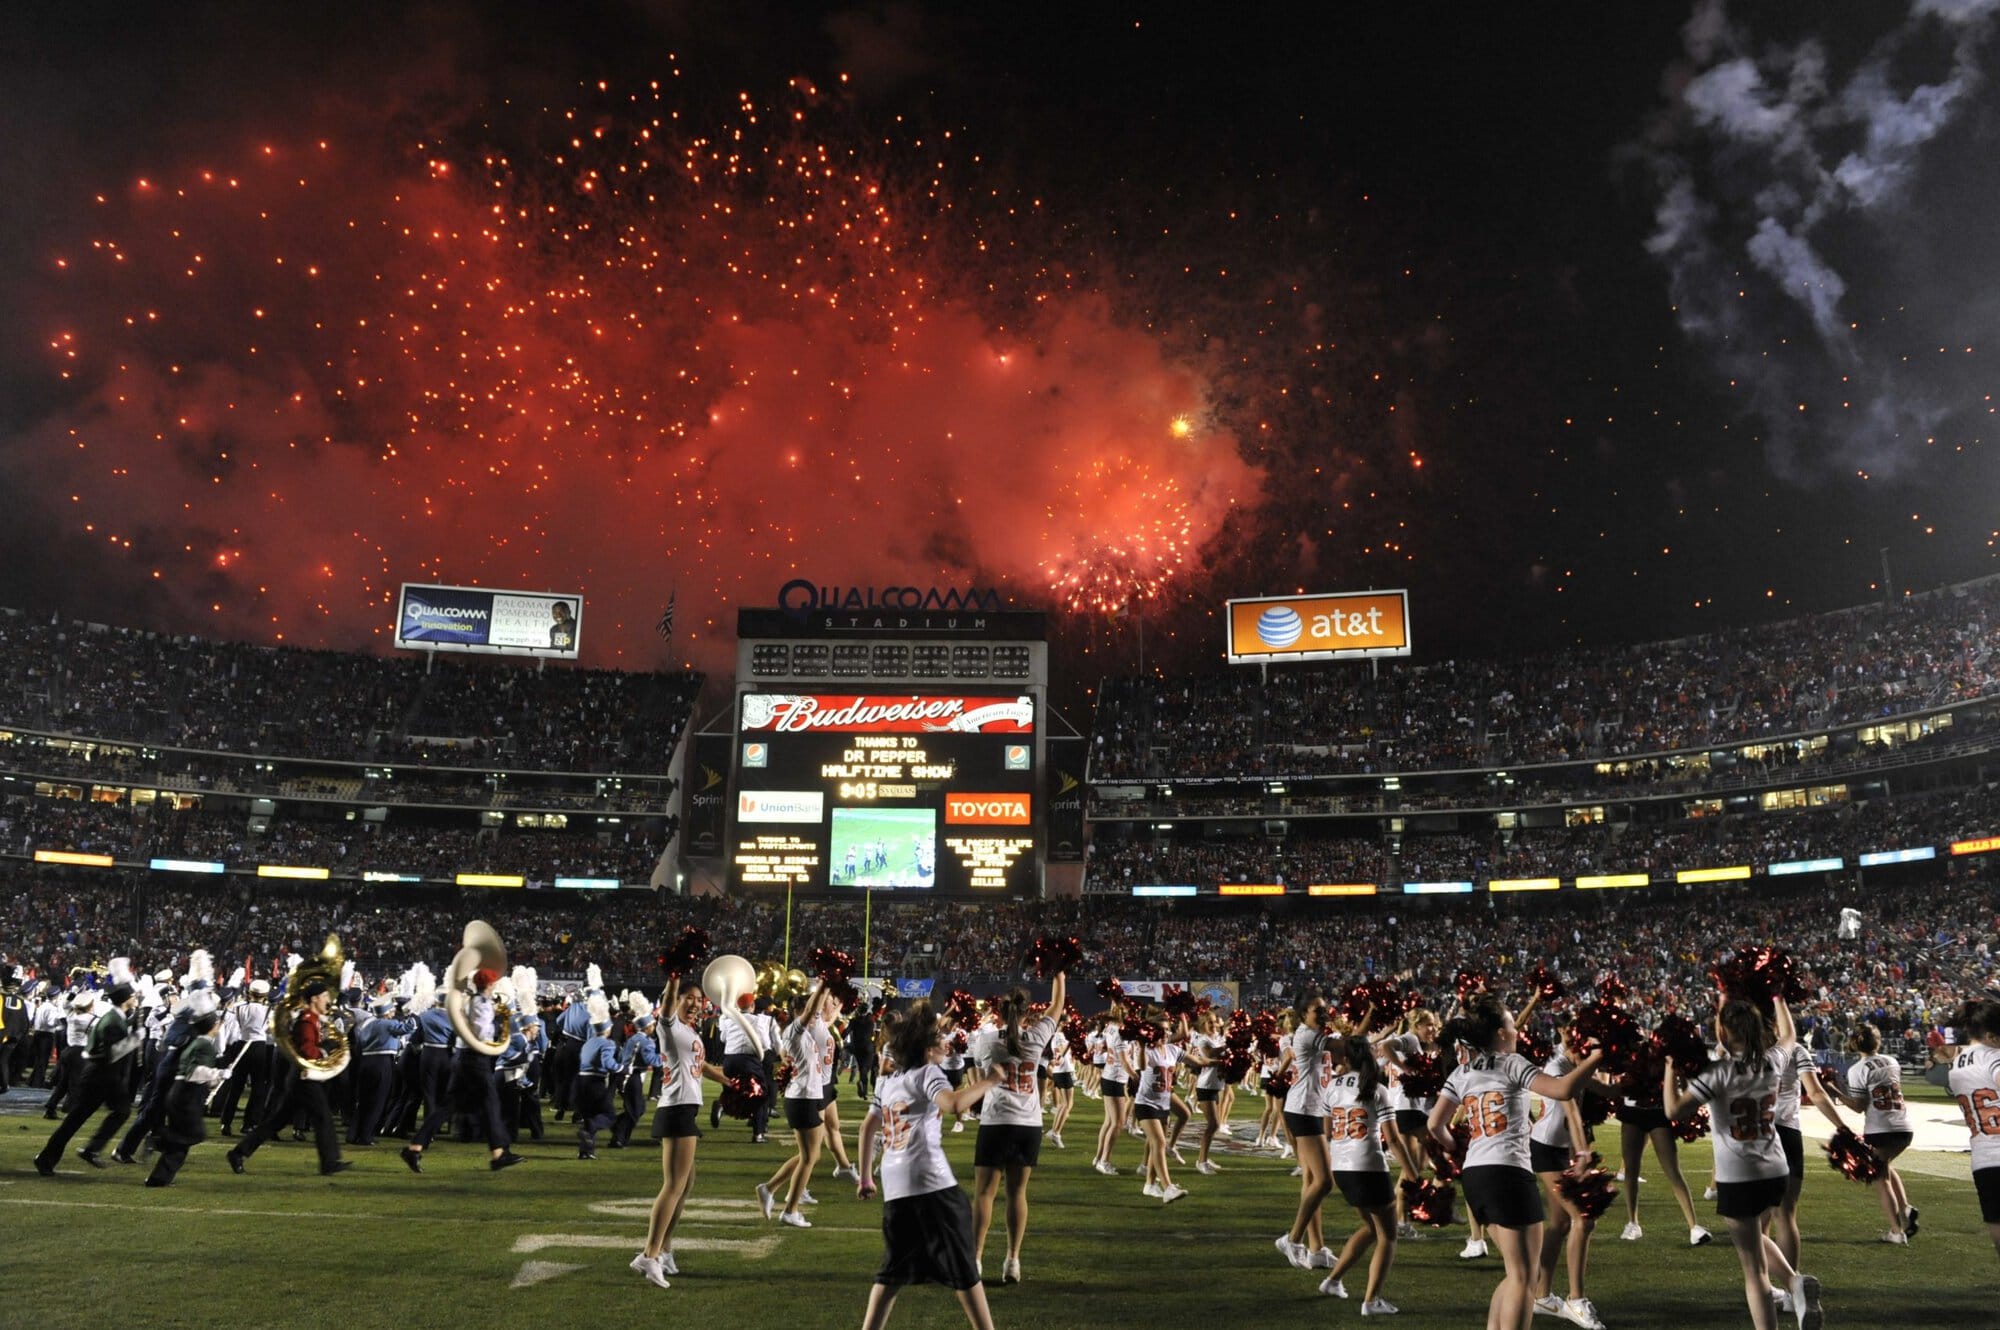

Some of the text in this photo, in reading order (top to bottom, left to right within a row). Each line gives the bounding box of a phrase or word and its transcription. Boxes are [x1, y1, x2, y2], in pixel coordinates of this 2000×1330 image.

[496, 599, 550, 609] PALOMAR
[778, 579, 1001, 625] QUALCOMM
[407, 603, 487, 620] QUALCOMM
[496, 608, 550, 618] POMERADO
[421, 621, 473, 631] innovation
[495, 618, 549, 628] HEALTH
[825, 618, 985, 628] STADIUM
[1311, 607, 1384, 638] at&t
[771, 696, 964, 731] Budweiser
[854, 737, 918, 748] THANKS TO
[843, 750, 926, 763] DR PEPPER
[822, 764, 952, 778] HALFTIME SHOW
[950, 802, 1026, 817] TOYOTA
[1952, 840, 1990, 854] WELLS
[1335, 1076, 1356, 1087] BG
[1462, 1091, 1508, 1140] 36
[1332, 1107, 1369, 1140] 36
